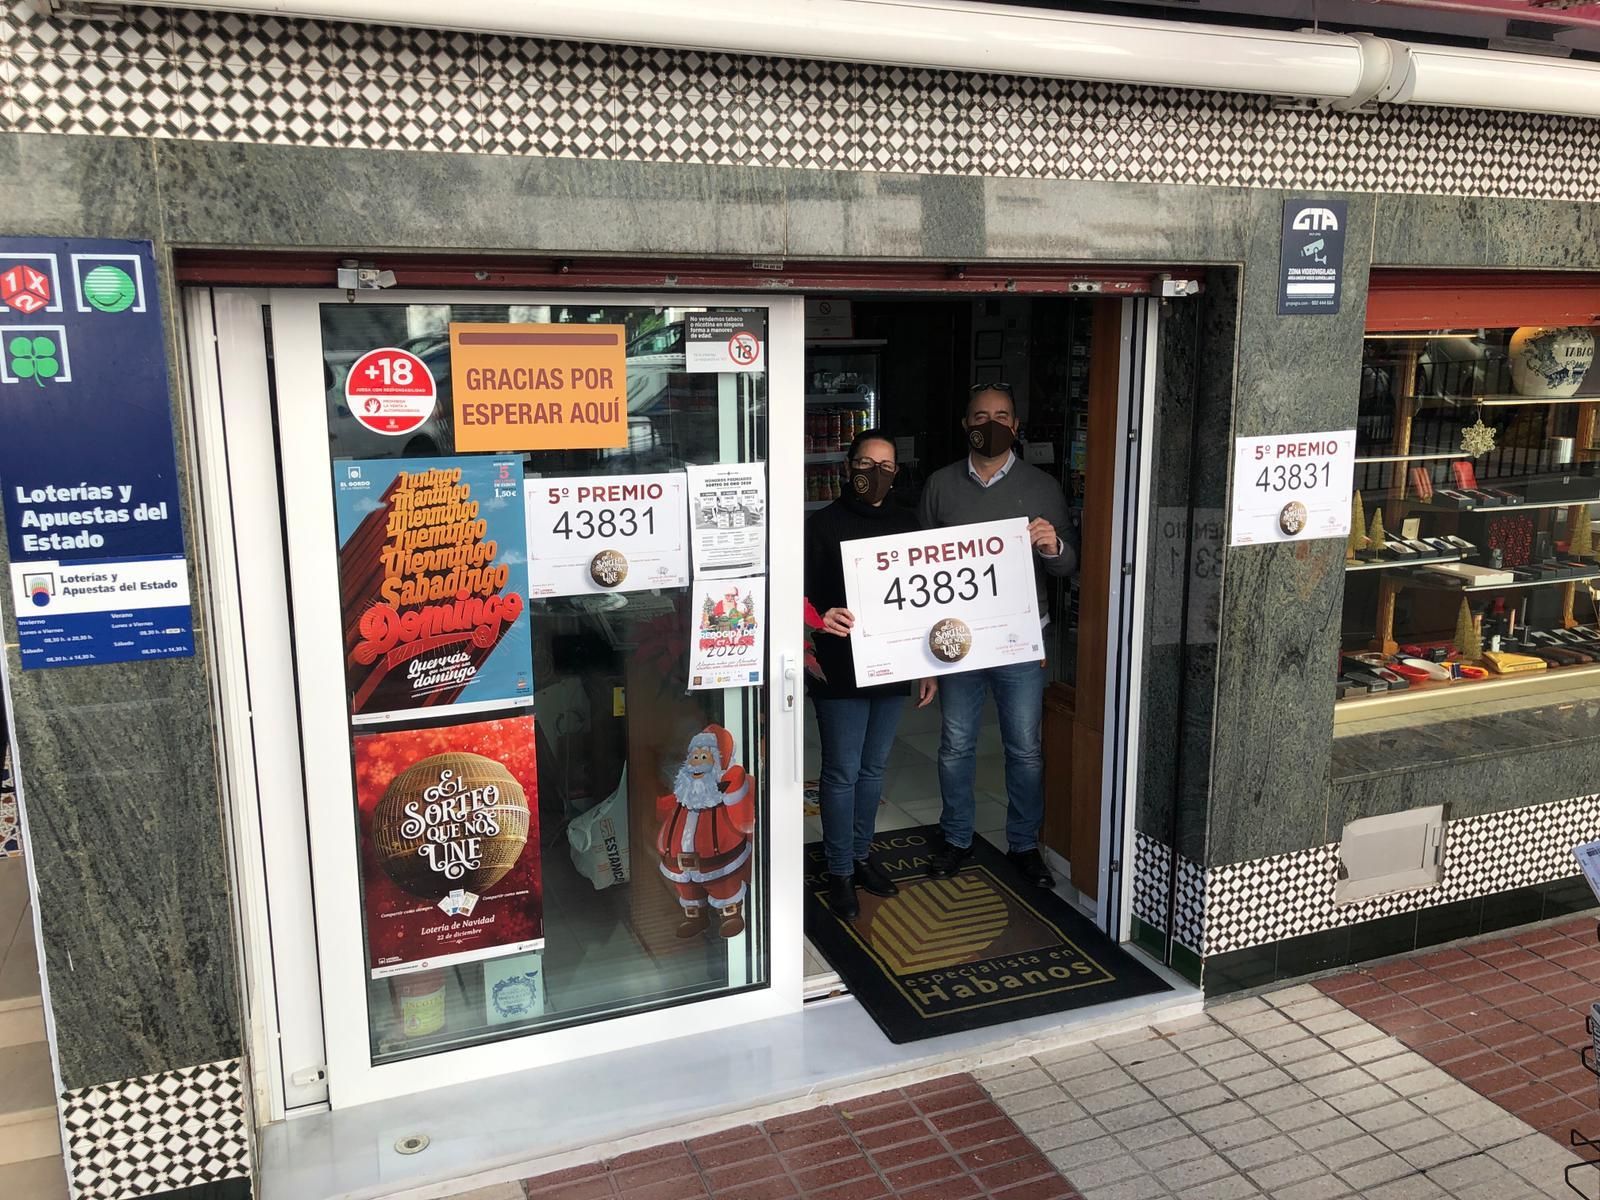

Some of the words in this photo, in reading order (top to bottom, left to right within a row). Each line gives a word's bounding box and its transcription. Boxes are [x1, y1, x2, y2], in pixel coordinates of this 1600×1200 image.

[1292, 207, 1339, 231] GTA
[364, 358, 414, 386] +18
[466, 368, 564, 390] GRACIAS
[571, 368, 614, 390] POR
[462, 403, 562, 425] ESPERAR
[570, 397, 620, 425] AQUÍ
[1255, 445, 1271, 460] 5º
[1276, 440, 1338, 459] PREMIO
[500, 465, 509, 479] 5
[1255, 461, 1330, 492] 43831
[16, 482, 113, 503] Loterías
[118, 485, 132, 503] y
[548, 487, 570, 505] 5º
[578, 483, 663, 503] PREMIO
[22, 507, 130, 531] Apuestas
[134, 502, 168, 521] del
[552, 506, 654, 540] 43831
[22, 530, 105, 552] Estado
[876, 550, 899, 571] 5º
[908, 536, 1004, 567] PREMIO
[60, 573, 108, 584] Loterías
[111, 573, 118, 583] y
[63, 583, 115, 597] Apuestas
[119, 581, 136, 592] del
[140, 580, 178, 590] Estado
[381, 564, 509, 611] Sabadingo
[883, 563, 999, 611] 43831
[353, 589, 524, 665] Domingo
[407, 650, 471, 679] Querrás
[707, 644, 748, 658] 2020
[413, 666, 477, 689] domingo
[424, 769, 468, 802] EL
[401, 785, 500, 839] SORTEO
[427, 822, 461, 844] QUE
[465, 811, 500, 836] NOS
[418, 837, 483, 879] UNE
[421, 923, 449, 936] Lotería
[451, 920, 460, 930] de
[461, 915, 495, 928] Navidad
[445, 932, 452, 940] de
[453, 928, 482, 938] diciembre
[905, 955, 1041, 988] especialista
[1049, 949, 1075, 960] en
[912, 961, 1093, 1006] Habanos
